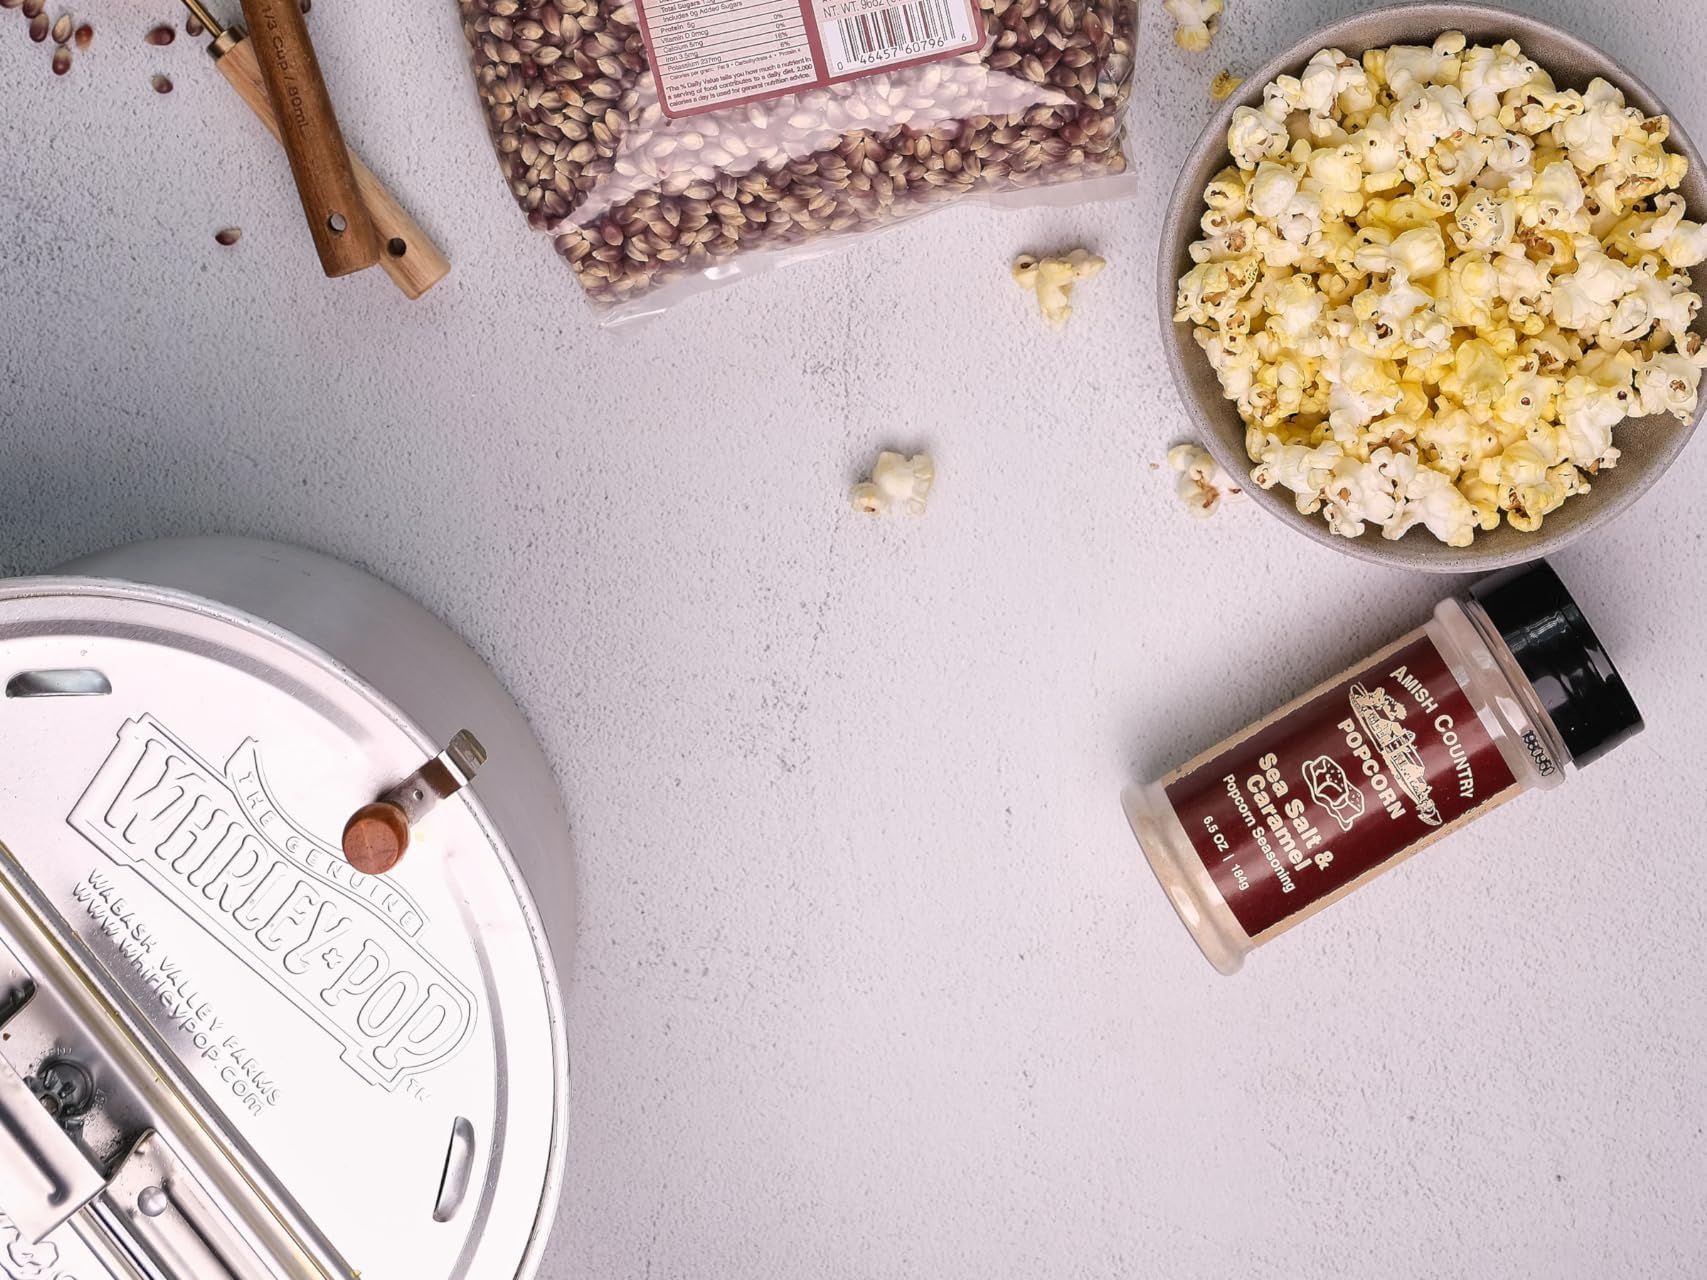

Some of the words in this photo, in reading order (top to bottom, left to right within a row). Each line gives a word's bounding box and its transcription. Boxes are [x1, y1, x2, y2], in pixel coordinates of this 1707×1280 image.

[262, 5, 278, 31] 1/3
[273, 36, 289, 71] Cup
[823, 4, 840, 18] NT.
[840, 0, 860, 14] WT.
[836, 61, 844, 71] 0
[859, 47, 898, 65] 46457
[905, 37, 945, 55] 60796
[961, 33, 967, 42] 6
[1337, 718, 1406, 819] POPCORN
[1389, 665, 1439, 714] AMISH
[1434, 714, 1474, 798] COUNTRY
[237, 771, 280, 826] THE
[286, 835, 415, 928] GENUINE
[1203, 816, 1219, 833] 6.5
[1213, 833, 1229, 852] OZ
[1231, 863, 1250, 891] 184g
[1223, 774, 1256, 827] Popcorn
[1252, 826, 1295, 893] Seasoning
[1247, 774, 1313, 871] Caramel
[1259, 753, 1289, 798] Sea
[1285, 799, 1322, 850] Salt
[1314, 850, 1334, 871] &
[103, 738, 351, 975] WHIRLEY
[320, 939, 463, 1069] POP
[88, 869, 157, 955] WABASH
[159, 956, 223, 1032] VALLEY
[222, 1035, 279, 1107] FARMS
